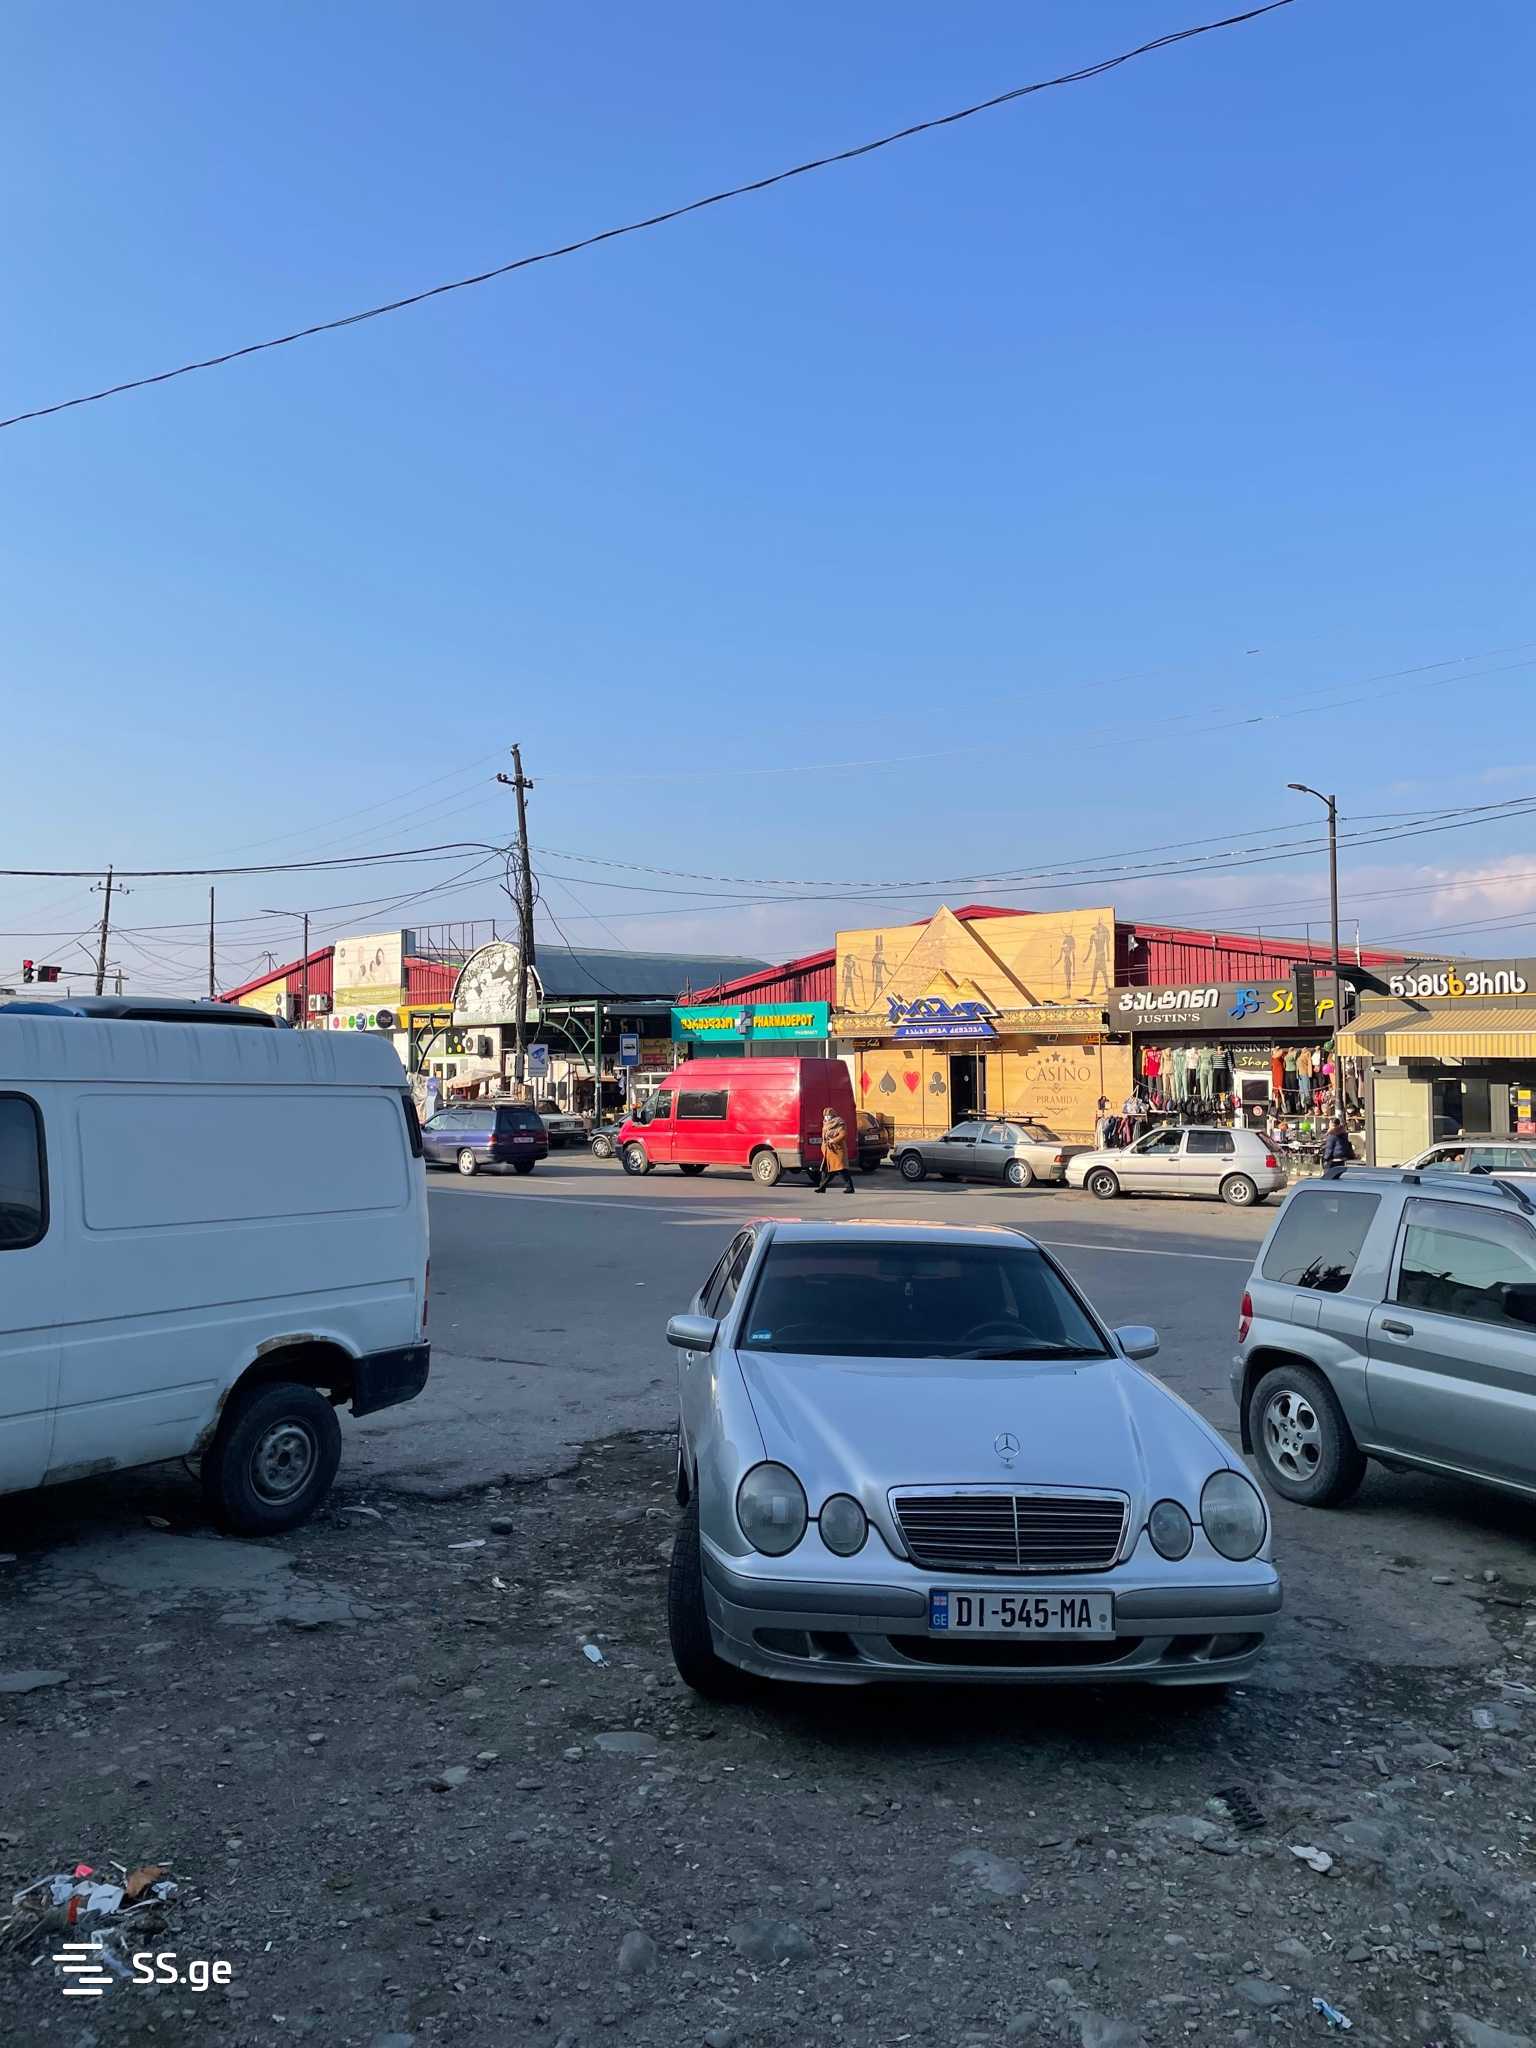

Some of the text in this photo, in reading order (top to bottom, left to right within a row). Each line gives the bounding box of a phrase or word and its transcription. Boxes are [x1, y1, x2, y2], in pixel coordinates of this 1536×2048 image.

[1389, 966, 1528, 997] ნამცხვრის
[1118, 988, 1220, 1011] ჯასტინი
[753, 1014, 815, 1028] PHARMADEPOT
[1136, 1013, 1201, 1025] JUSTIN'S
[1239, 1056, 1270, 1069] Shop
[1026, 1066, 1091, 1081] CASINO
[1036, 1095, 1079, 1105] PIRAMIDA
[956, 1596, 1092, 1628] DI-545-MA
[933, 1613, 947, 1626] GE
